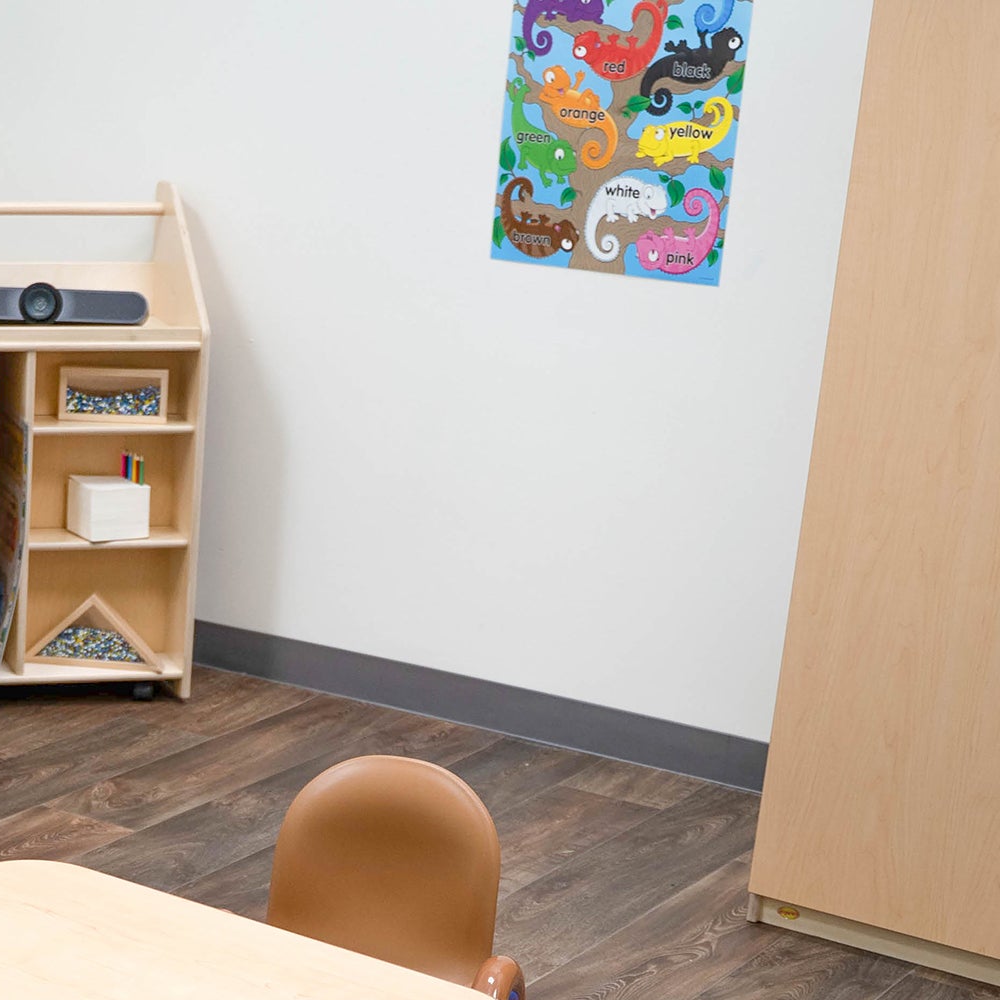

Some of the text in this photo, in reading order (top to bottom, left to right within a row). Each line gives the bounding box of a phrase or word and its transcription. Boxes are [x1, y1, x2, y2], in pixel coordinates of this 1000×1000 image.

[603, 61, 626, 73] red
[672, 62, 712, 79] black
[559, 107, 606, 123] orange
[516, 130, 551, 144] green
[669, 126, 713, 139] yellow
[605, 184, 640, 199] white
[512, 230, 551, 246] brown
[665, 250, 695, 266] pink
